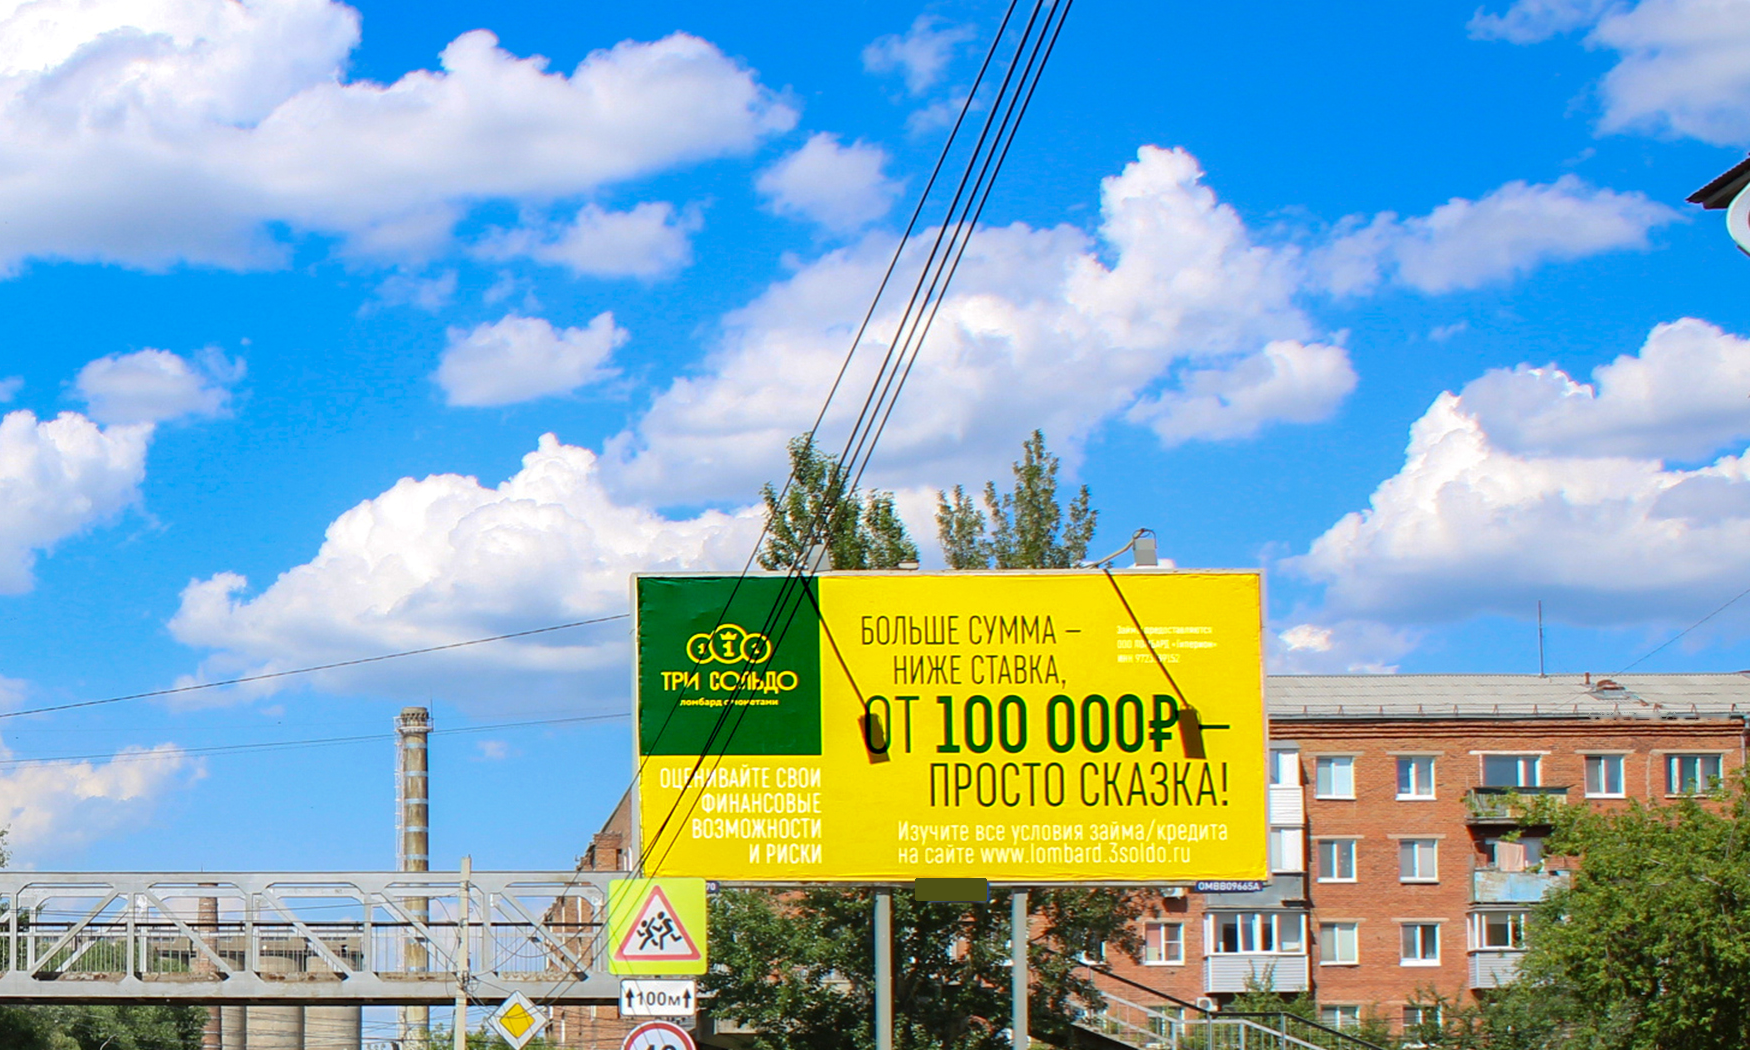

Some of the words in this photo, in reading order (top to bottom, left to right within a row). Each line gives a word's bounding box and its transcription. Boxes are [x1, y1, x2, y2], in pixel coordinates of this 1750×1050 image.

[861, 615, 960, 645] БОЛЬШЕ
[968, 615, 1057, 645] СУММА
[661, 671, 699, 691] ТРИ
[709, 670, 799, 694] СОЛЬДО
[893, 654, 962, 684] НИЖЕ
[971, 654, 1067, 689] СТАВКА,
[679, 697, 722, 707] ломбард
[865, 694, 920, 755] ОТ
[936, 694, 1028, 754] 100
[659, 764, 771, 790] ОЦЕНИВАЙТЕ
[776, 767, 821, 788] СВОИ
[930, 762, 1065, 807] ПРОСТО
[1080, 762, 1229, 807] СКАЗКА!
[700, 793, 822, 813] ФИНАНСОВЫЕ
[692, 818, 822, 839] ВОЗМОЖНОСТИ
[898, 821, 969, 845] Изучите
[975, 827, 1005, 841] все
[1013, 826, 1084, 845] условия
[1090, 819, 1228, 845] займа/кредита
[749, 843, 760, 864] И
[766, 843, 822, 864] РИСКИ
[898, 848, 919, 864] на
[925, 844, 975, 864] сайте
[980, 842, 1192, 864] www.lombard.3soldo.ru
